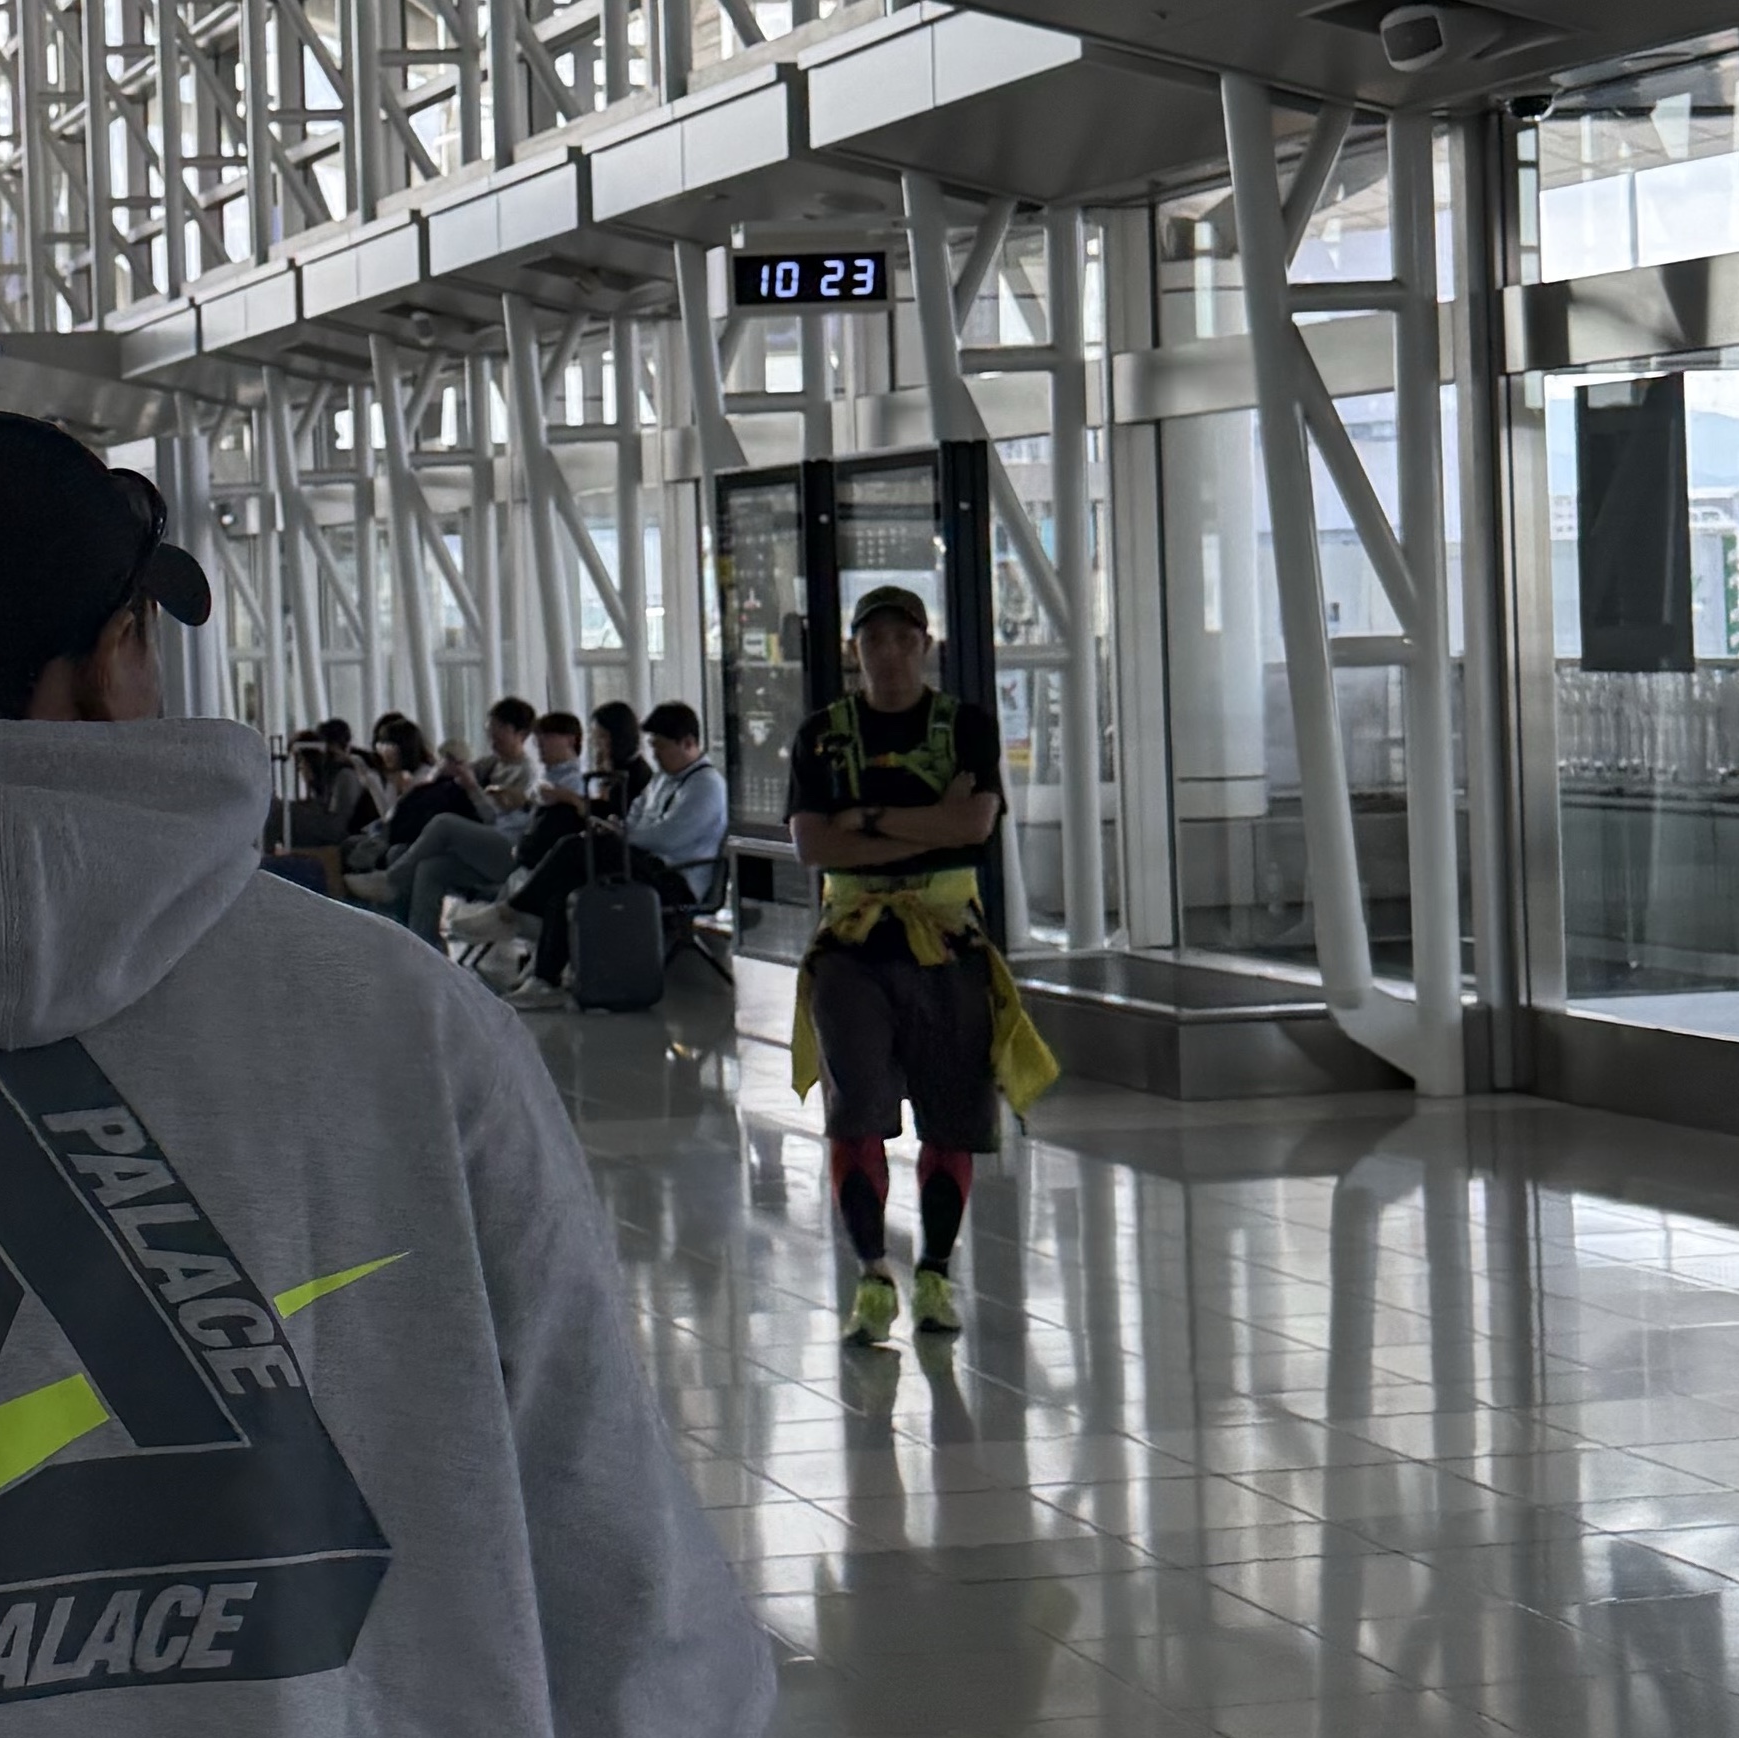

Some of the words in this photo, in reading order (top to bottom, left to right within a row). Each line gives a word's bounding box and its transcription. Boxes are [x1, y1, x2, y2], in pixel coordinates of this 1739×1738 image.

[760, 261, 800, 298] 10
[820, 258, 875, 296] 23
[41, 1105, 302, 1395] PALACE
